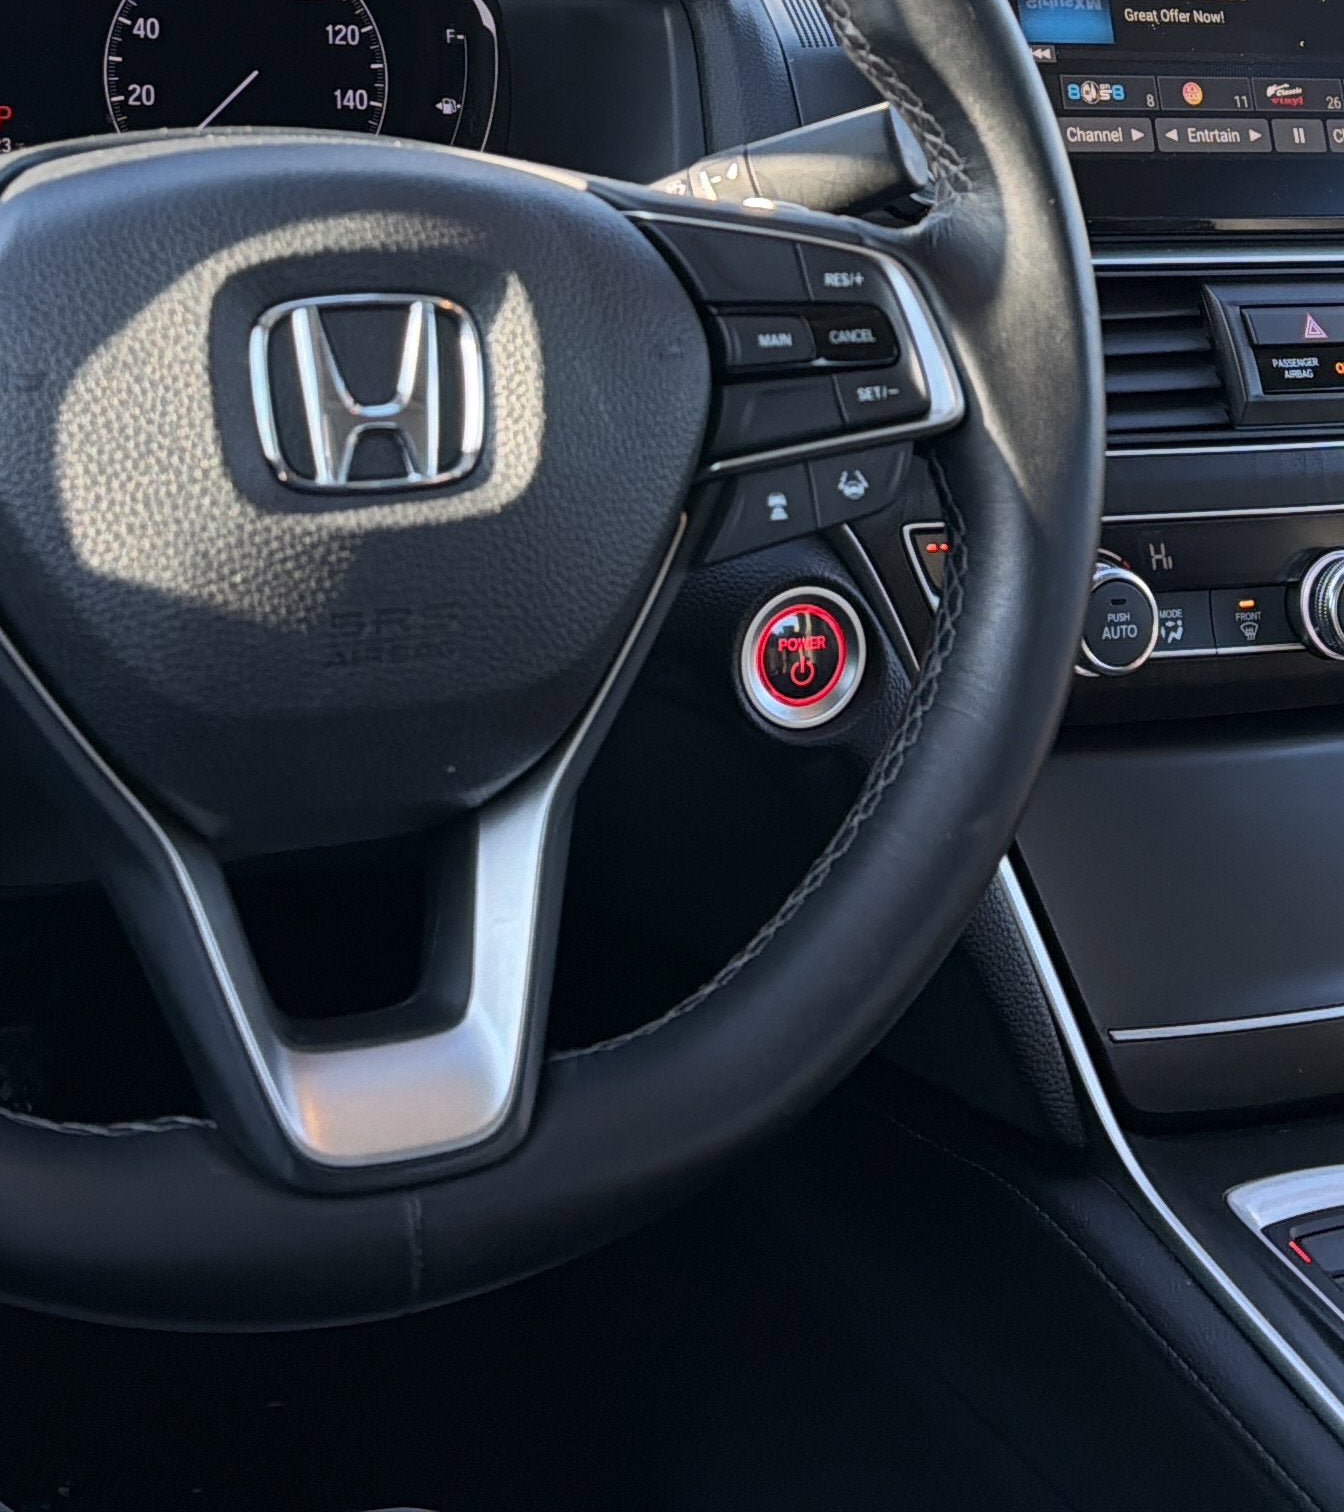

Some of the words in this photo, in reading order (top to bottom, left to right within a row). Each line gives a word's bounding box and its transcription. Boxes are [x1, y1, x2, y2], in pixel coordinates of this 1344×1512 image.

[1124, 7, 1158, 24] Great
[1160, 8, 1191, 24] Offer
[1193, 10, 1226, 25] Now!
[132, 17, 160, 39] 40
[325, 24, 360, 46] 120
[445, 29, 456, 43] F
[127, 84, 155, 106] 20
[333, 88, 369, 111] 140
[1146, 93, 1155, 108] 8
[1233, 94, 1249, 109] 11
[1325, 95, 1342, 110] 26
[1066, 127, 1124, 143] Channel
[1187, 127, 1241, 143] Entrtain
[757, 332, 793, 348] MAIN
[828, 328, 877, 345] CANCEL
[1271, 357, 1320, 369] PASSENGER
[1284, 368, 1314, 379] AIRBAG
[1107, 612, 1130, 623] PUSH
[1159, 608, 1184, 619] MODE
[1235, 610, 1262, 622] FRONT
[1101, 624, 1138, 640] AUTO
[778, 635, 827, 652] POWER
